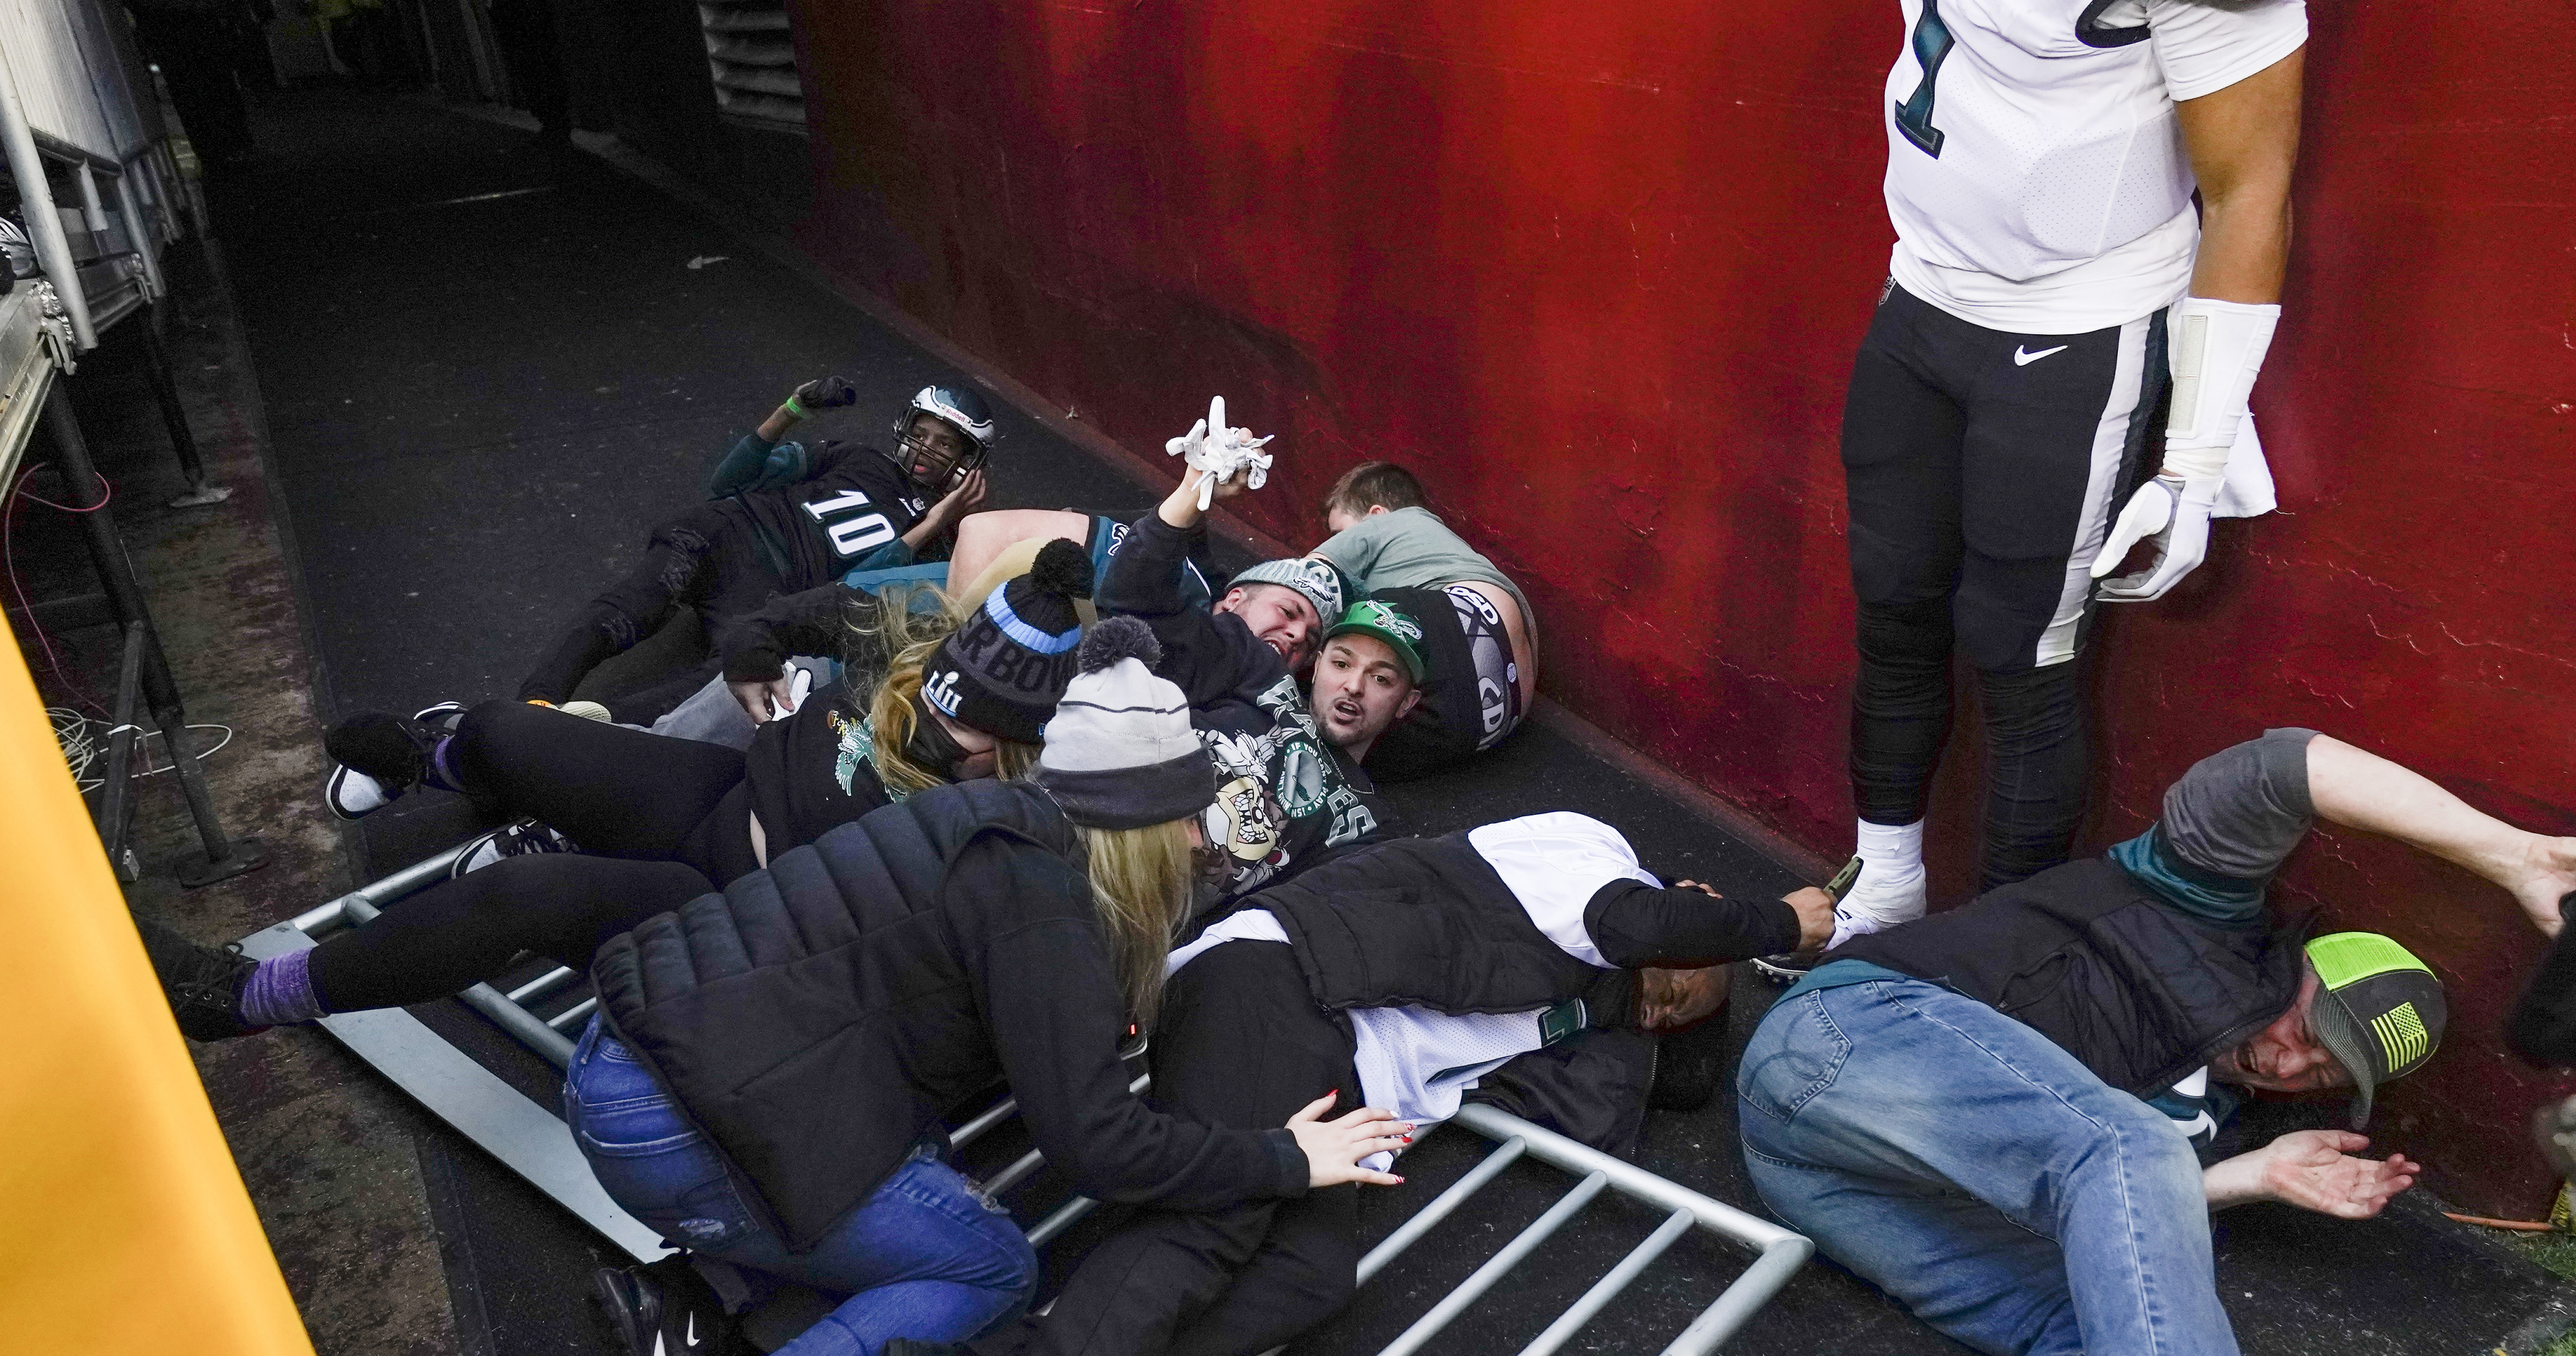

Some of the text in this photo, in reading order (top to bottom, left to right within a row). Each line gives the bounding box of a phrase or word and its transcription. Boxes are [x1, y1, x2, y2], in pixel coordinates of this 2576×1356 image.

[946, 409, 966, 422] Riddell
[801, 490, 895, 559] 10
[1291, 742, 1302, 751] IF
[1303, 742, 1318, 758] YOU
[1313, 786, 1329, 810] PLAY
